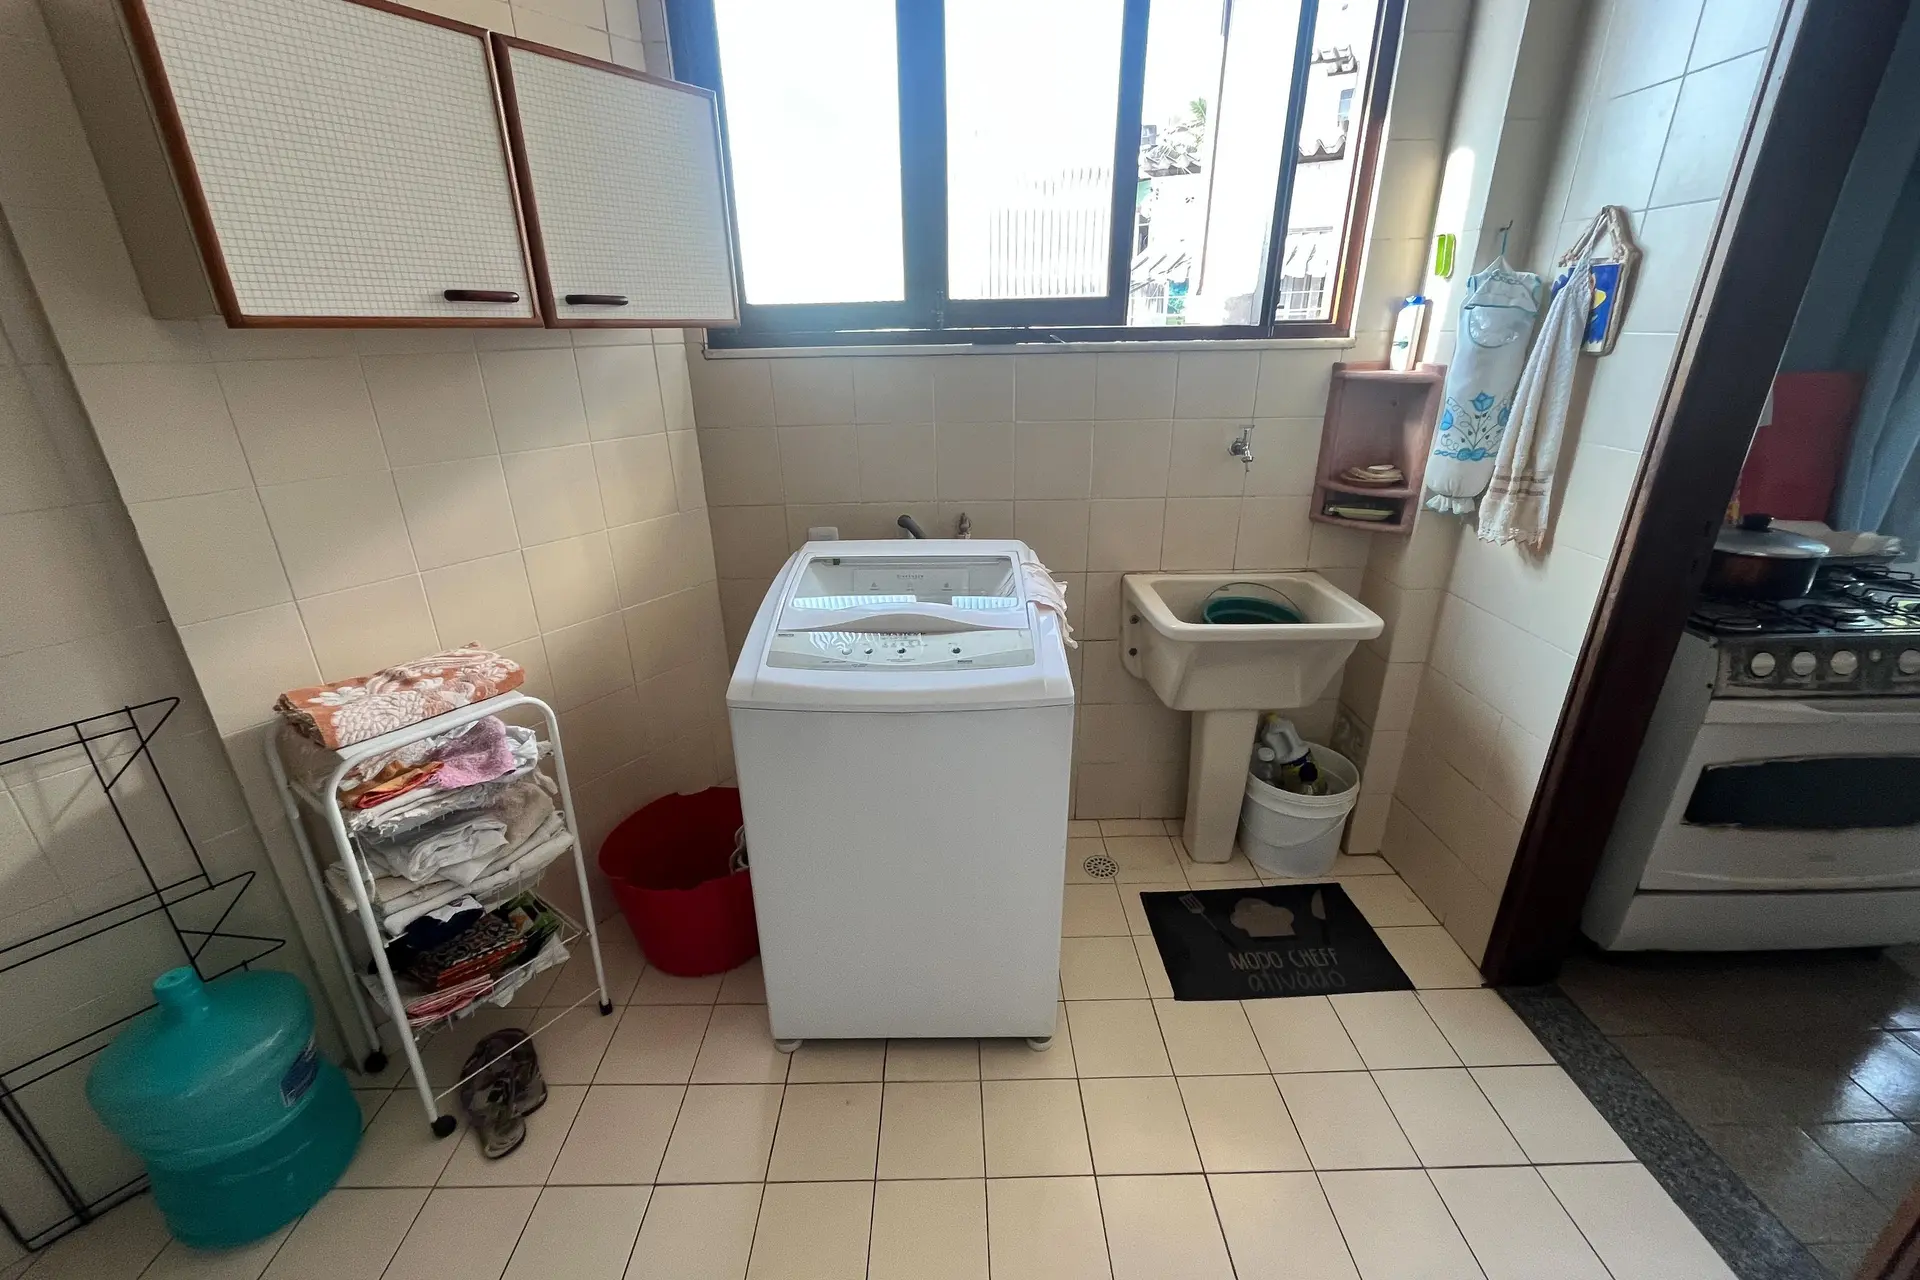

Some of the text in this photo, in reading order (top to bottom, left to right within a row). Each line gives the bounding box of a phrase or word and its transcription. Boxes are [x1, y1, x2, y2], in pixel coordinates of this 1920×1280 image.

[1227, 947, 1339, 970] MODO CHEFF
[1247, 966, 1347, 992] ativado
